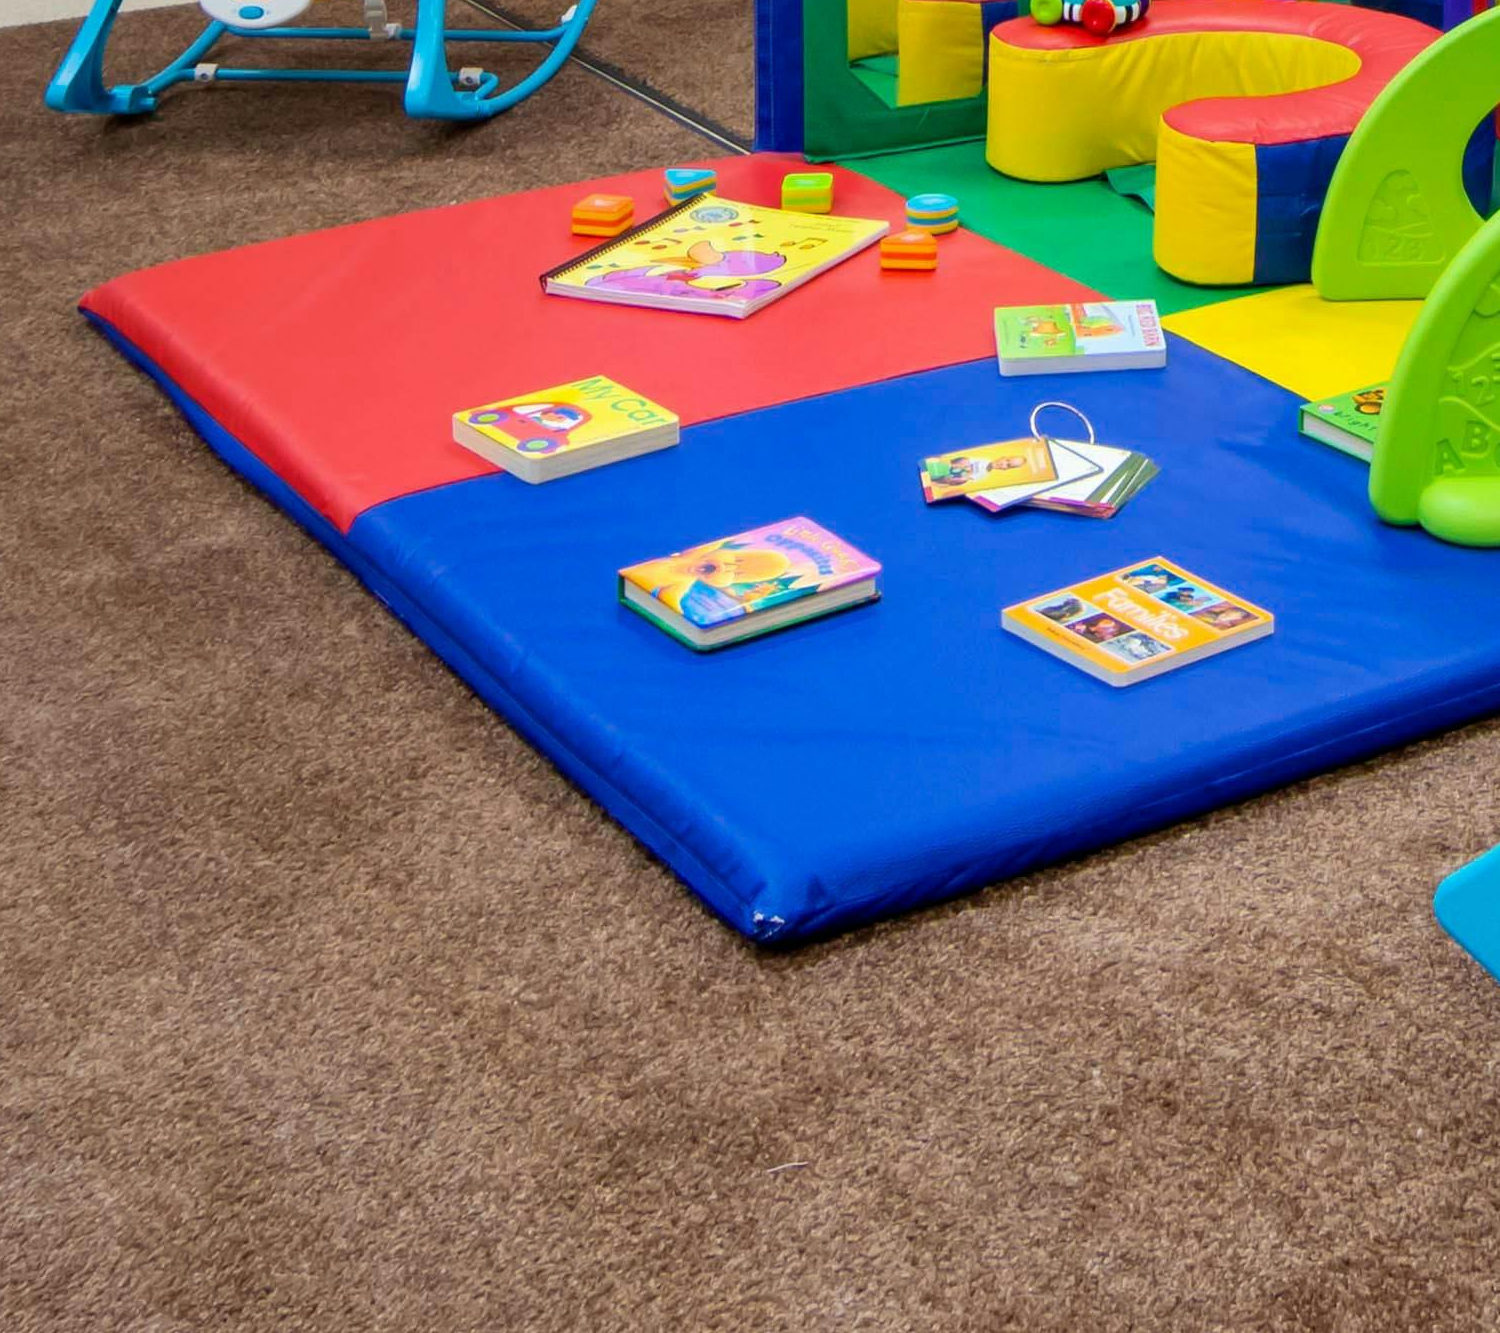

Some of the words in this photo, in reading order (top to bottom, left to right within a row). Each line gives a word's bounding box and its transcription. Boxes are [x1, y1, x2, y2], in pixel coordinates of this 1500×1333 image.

[570, 377, 622, 400] My
[611, 397, 669, 425] Car
[1091, 586, 1190, 641] Families
